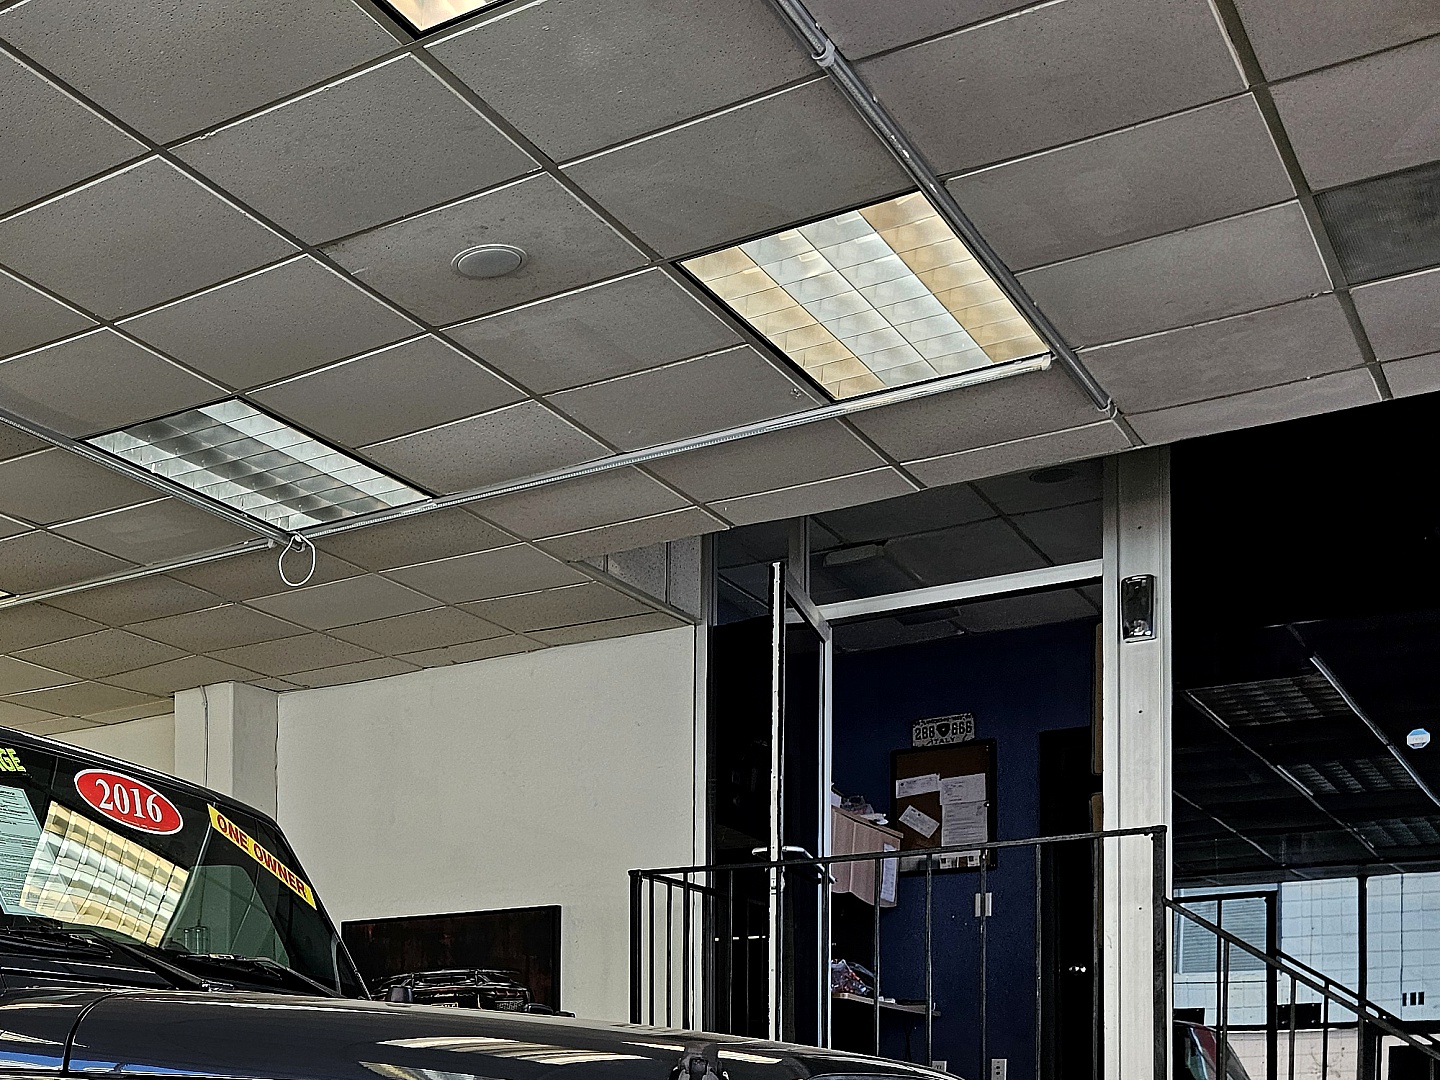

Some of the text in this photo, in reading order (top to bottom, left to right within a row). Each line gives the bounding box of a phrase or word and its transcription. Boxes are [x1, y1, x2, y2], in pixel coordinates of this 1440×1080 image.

[95, 778, 163, 823] 2016
[217, 815, 308, 898] ONE OWNER
